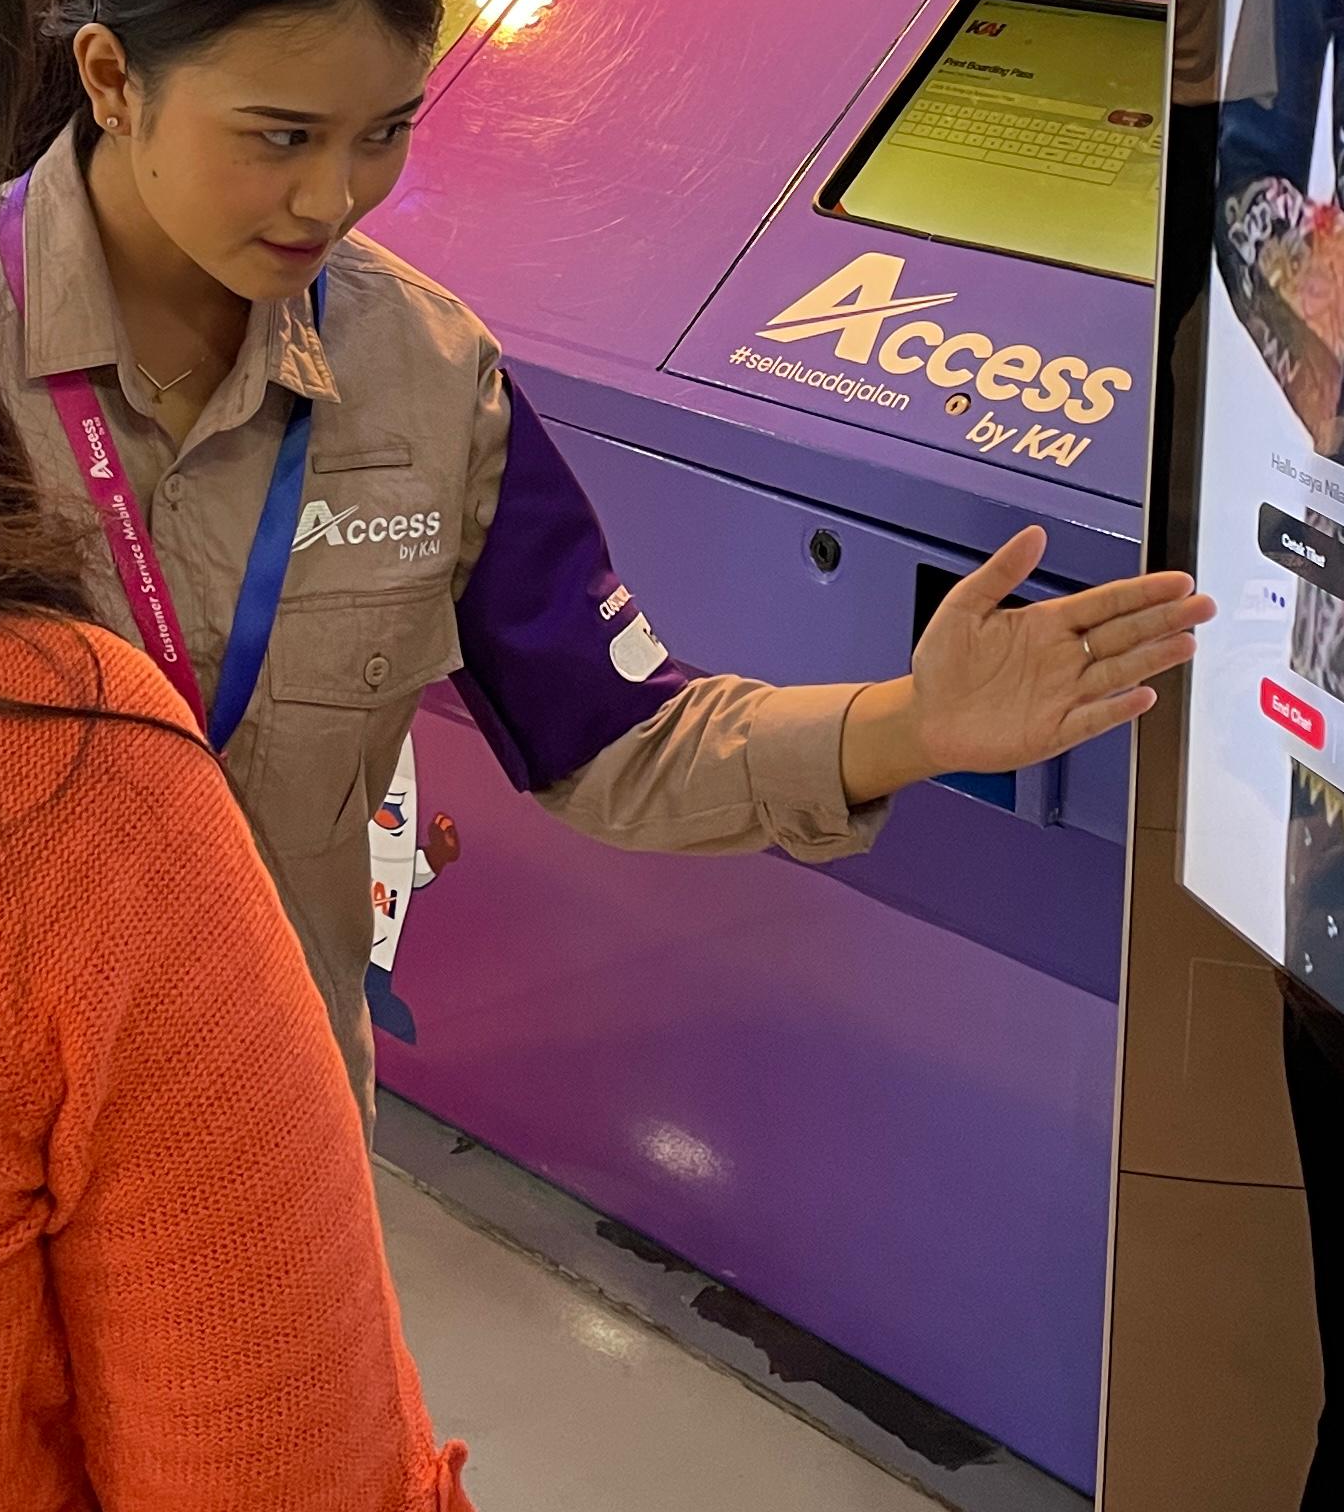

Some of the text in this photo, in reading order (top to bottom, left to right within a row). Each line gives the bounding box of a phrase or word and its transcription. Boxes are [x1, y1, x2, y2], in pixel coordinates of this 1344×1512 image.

[967, 61, 1009, 77] Boarding
[1010, 67, 1035, 80] Pass
[756, 252, 1133, 425] Access
[729, 345, 911, 412] #selaluadajalan
[82, 418, 114, 479] Access
[966, 411, 1093, 469] by KAI
[1271, 452, 1297, 479] Hallo
[1298, 474, 1323, 495] saya
[291, 500, 441, 553] Access
[399, 540, 441, 562] by KAI
[112, 494, 178, 663] Customer Service Mobile
[1271, 694, 1313, 734] End Chat
